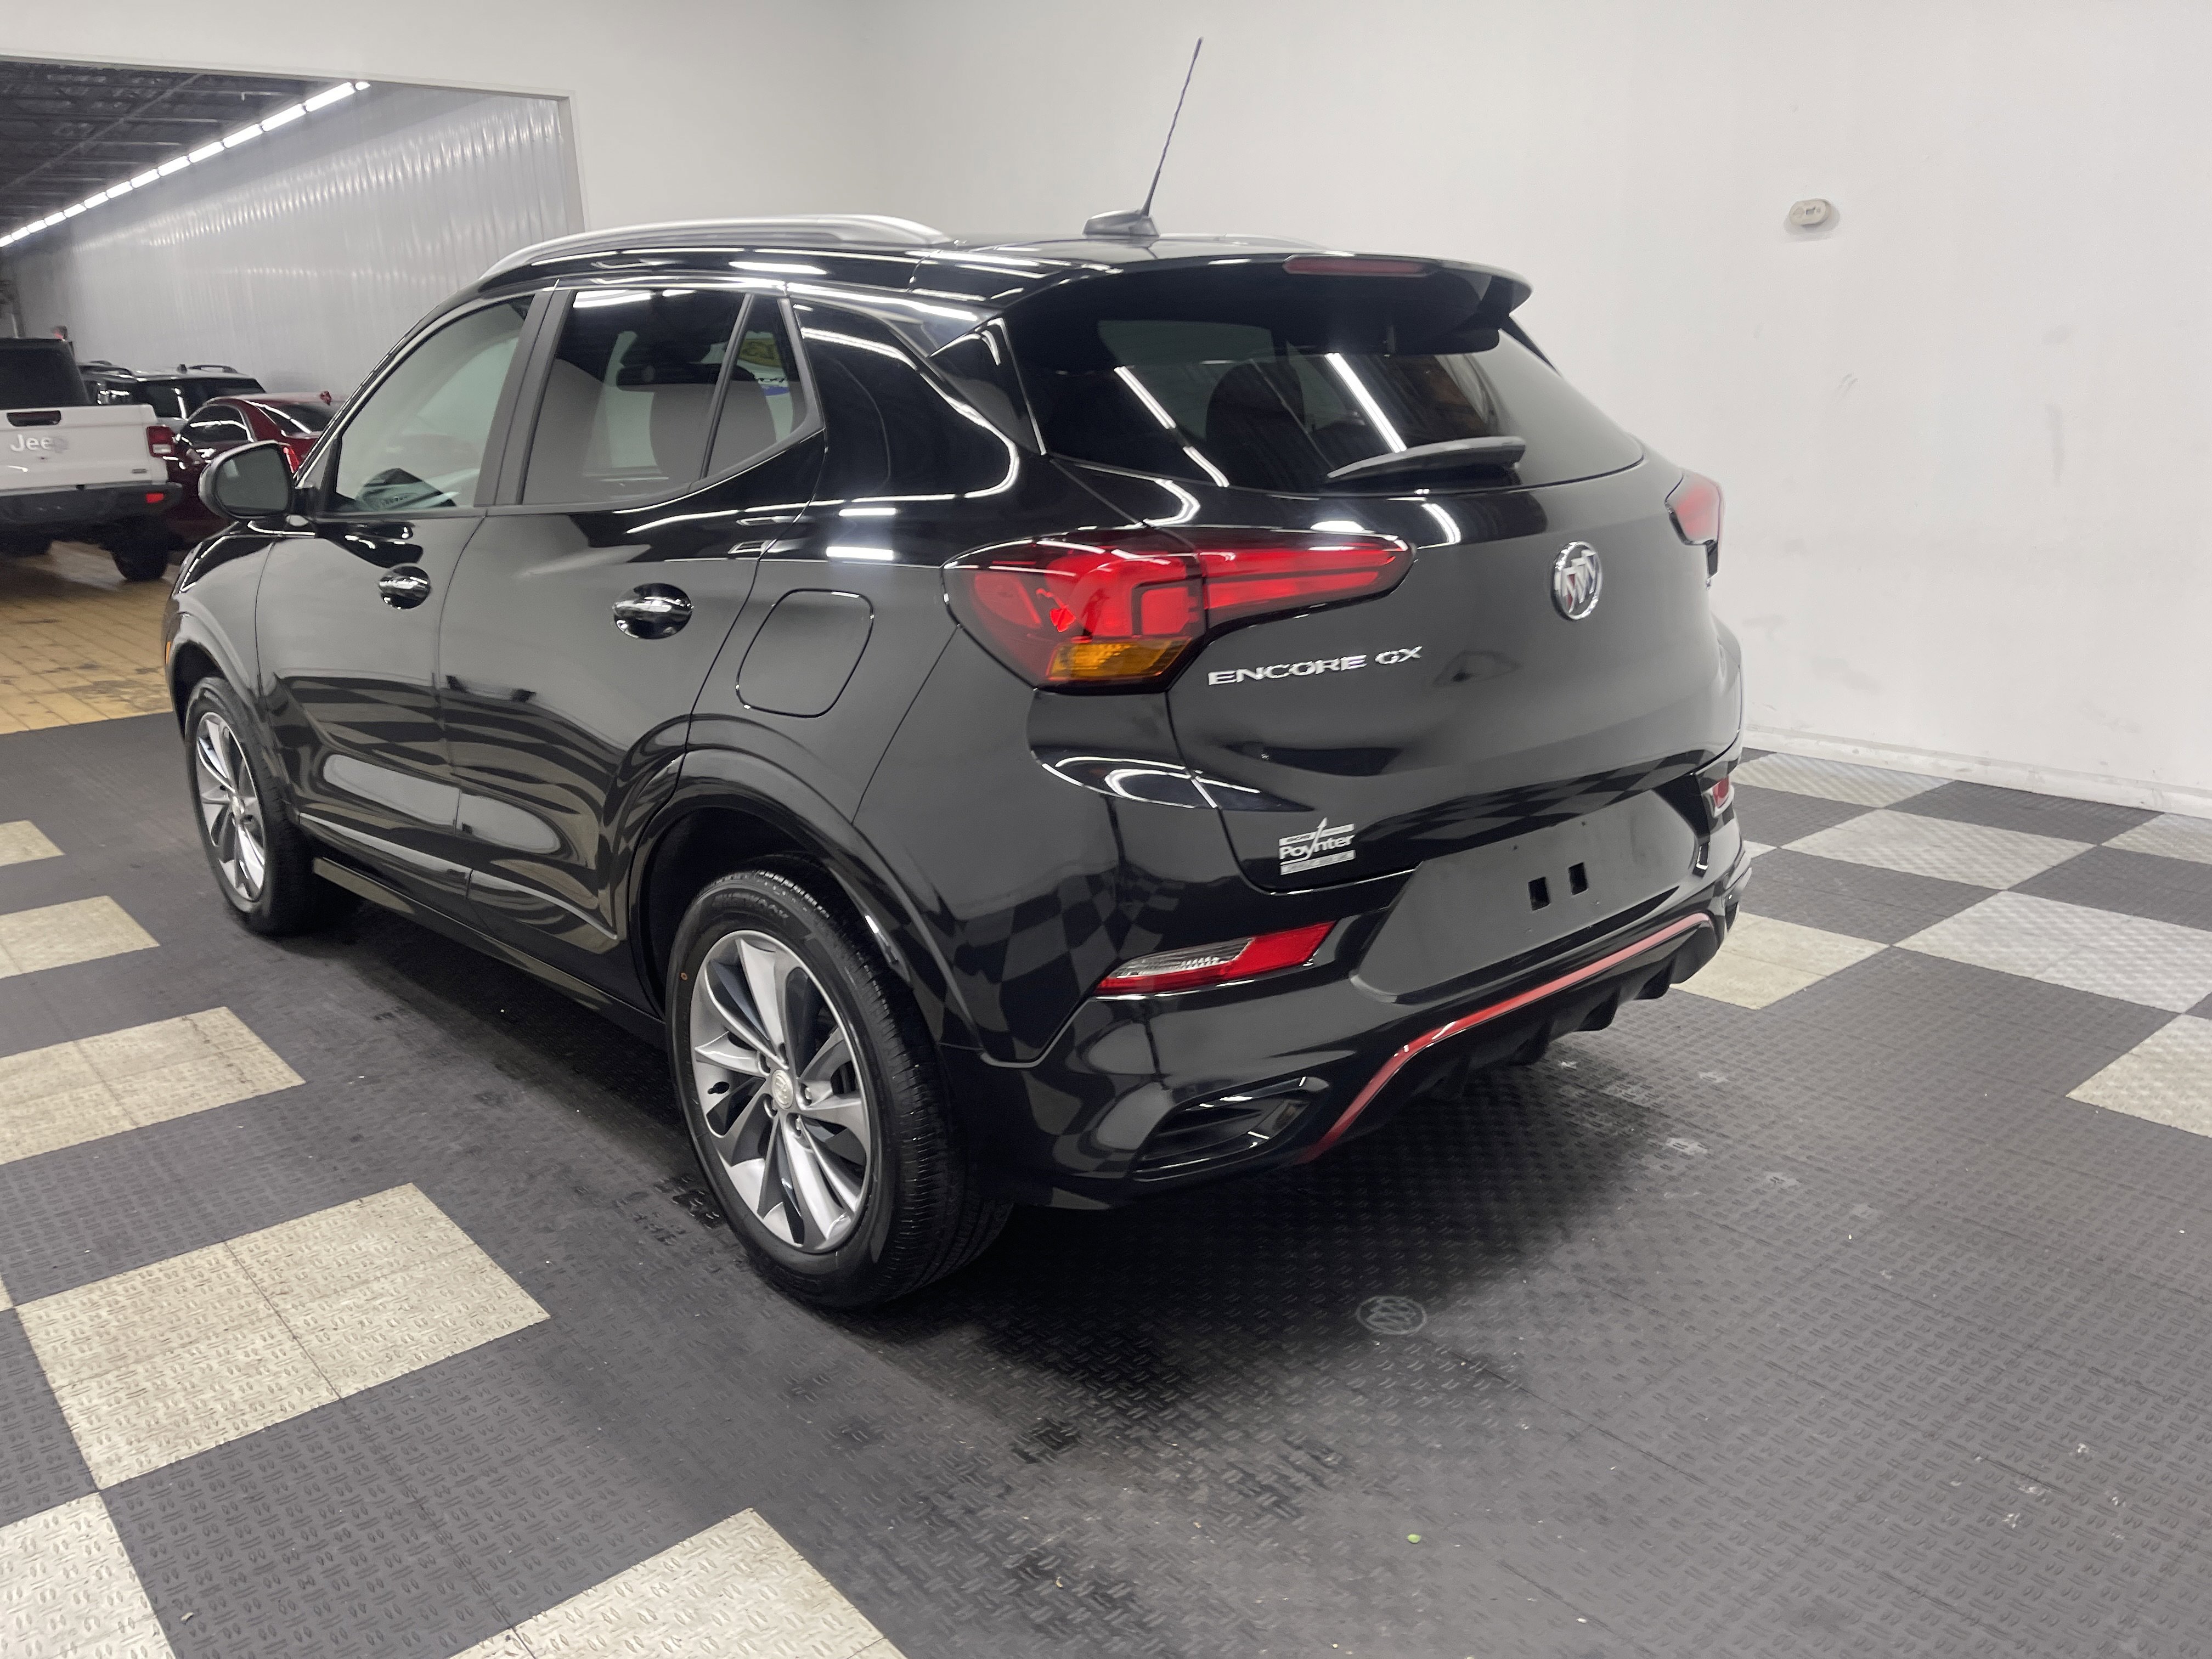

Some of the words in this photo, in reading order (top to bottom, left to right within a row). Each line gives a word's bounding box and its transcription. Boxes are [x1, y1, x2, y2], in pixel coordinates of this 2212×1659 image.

[1208, 654, 1368, 686] ENCORE
[1374, 646, 1423, 665] GX
[1279, 831, 1356, 865] Poynter
